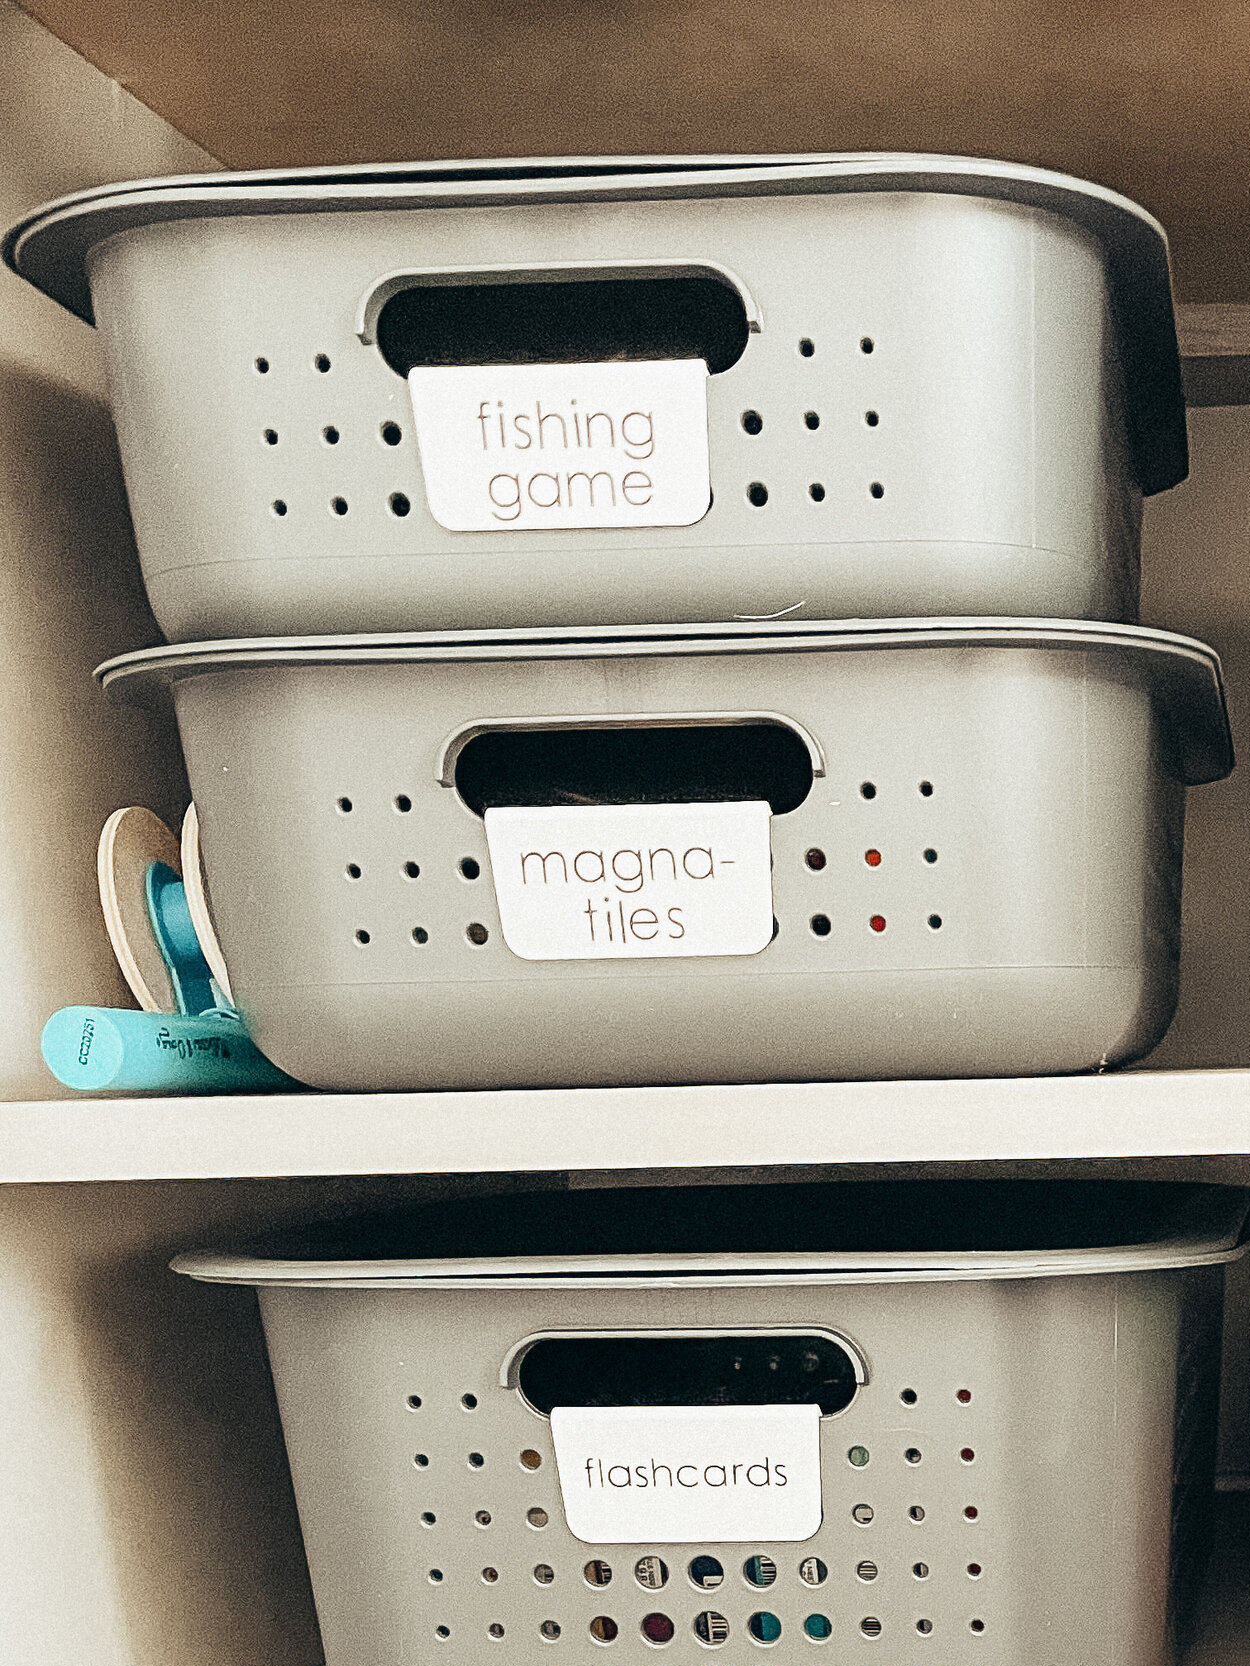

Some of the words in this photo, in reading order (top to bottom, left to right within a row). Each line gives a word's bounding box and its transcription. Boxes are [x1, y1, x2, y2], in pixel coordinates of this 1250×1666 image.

[477, 399, 655, 459] fishing
[490, 464, 652, 520] game
[520, 844, 736, 893] magna-
[584, 896, 686, 945] tiles
[584, 1457, 789, 1488] flashcards
